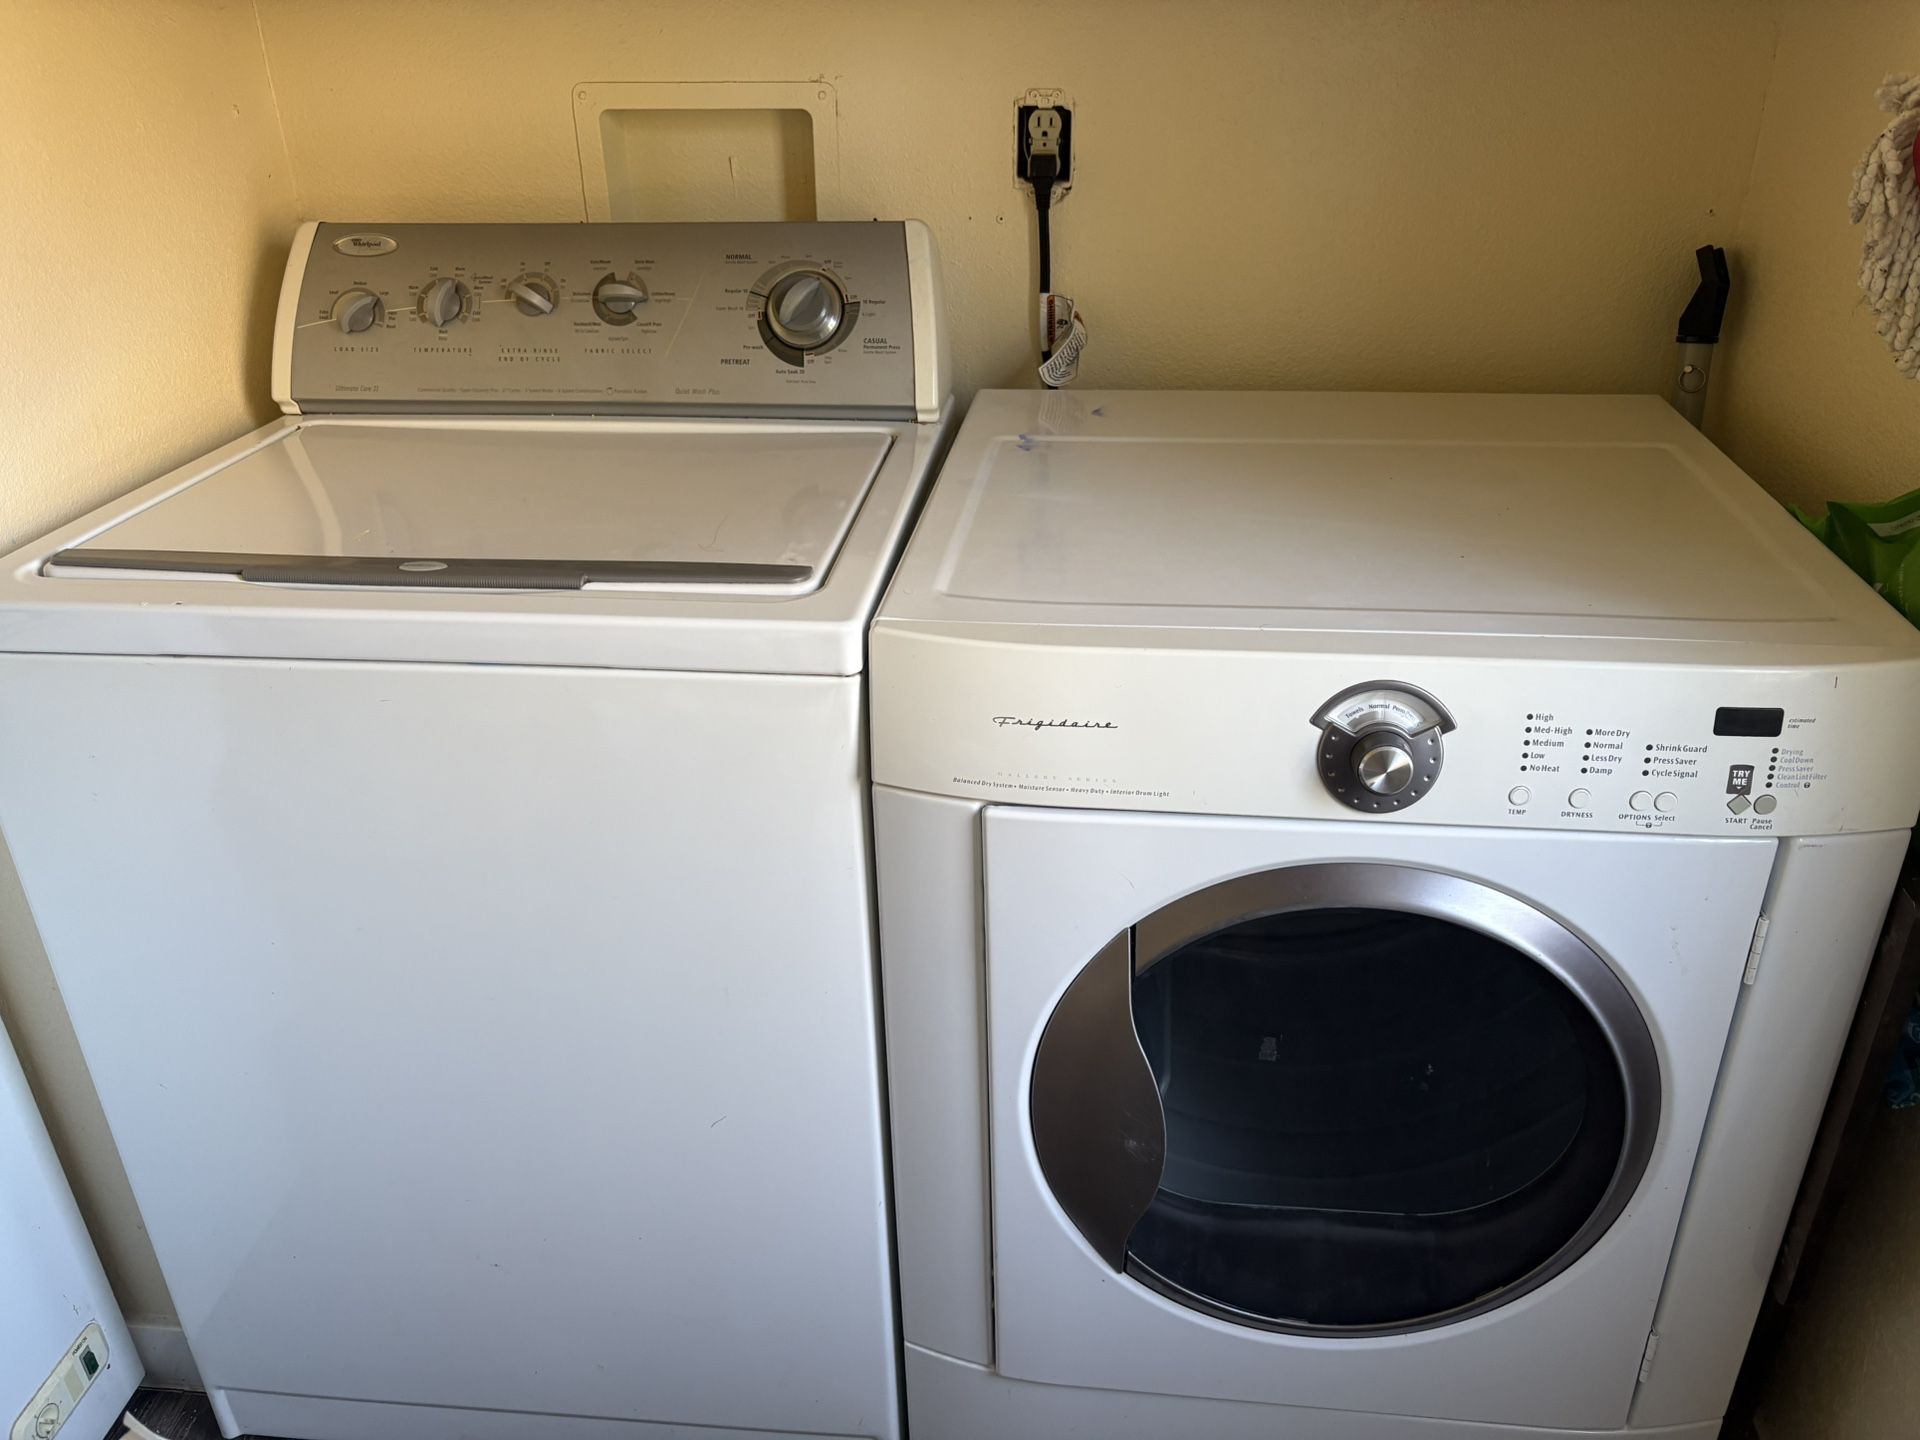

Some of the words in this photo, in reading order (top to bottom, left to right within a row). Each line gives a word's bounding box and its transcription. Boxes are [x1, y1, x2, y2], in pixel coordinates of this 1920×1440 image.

[352, 239, 382, 248] Whirlpool
[1535, 713, 1554, 722] High
[992, 716, 1118, 730] Frigidaire
[1533, 726, 1573, 736] Med-High
[1532, 739, 1564, 747] Medium
[1593, 742, 1623, 750] Normal
[1781, 749, 1804, 757] Drying
[1589, 767, 1613, 776] Damp
[1732, 770, 1751, 778] TRY
[953, 777, 981, 786] Balanced
[1732, 778, 1748, 786] ME
[1654, 814, 1676, 822] Select
